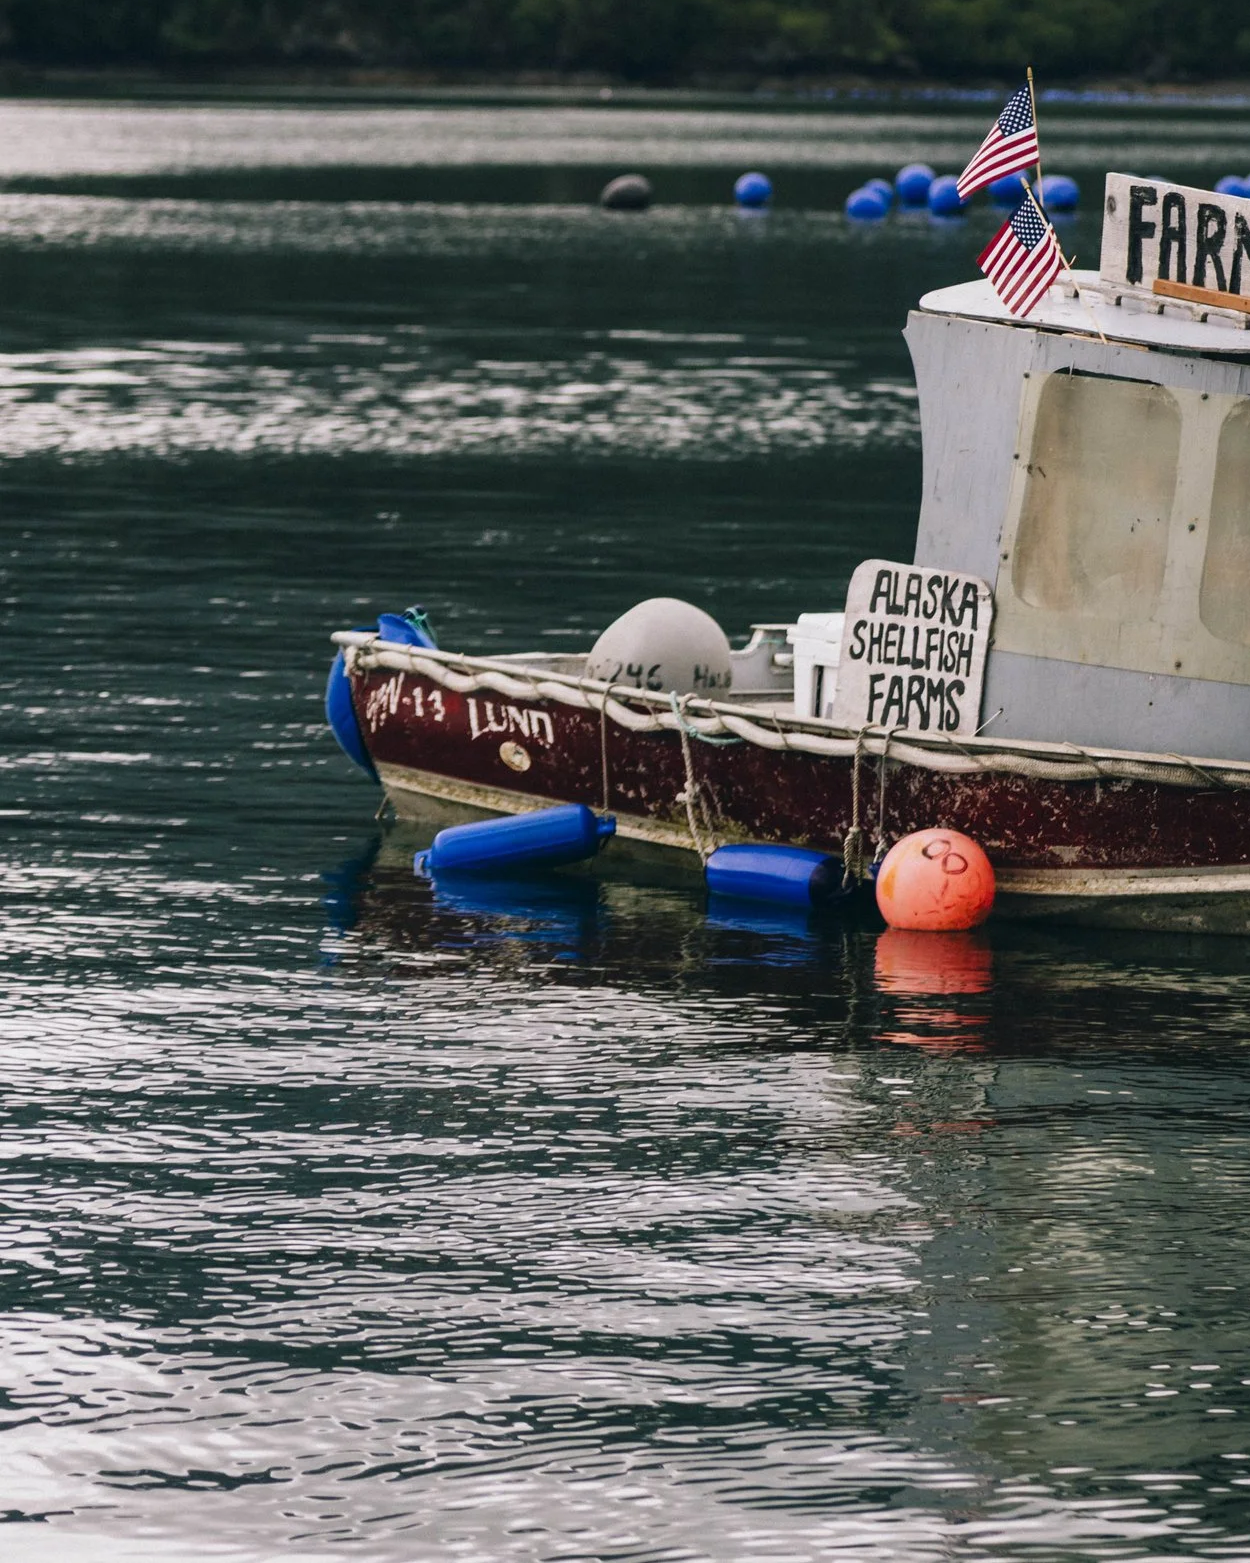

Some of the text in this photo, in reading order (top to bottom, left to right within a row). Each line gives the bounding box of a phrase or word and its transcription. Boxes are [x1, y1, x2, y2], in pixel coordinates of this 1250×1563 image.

[869, 569, 979, 631] ALASKA
[850, 619, 974, 677] SHELLFISH
[866, 673, 966, 732] FARMS
